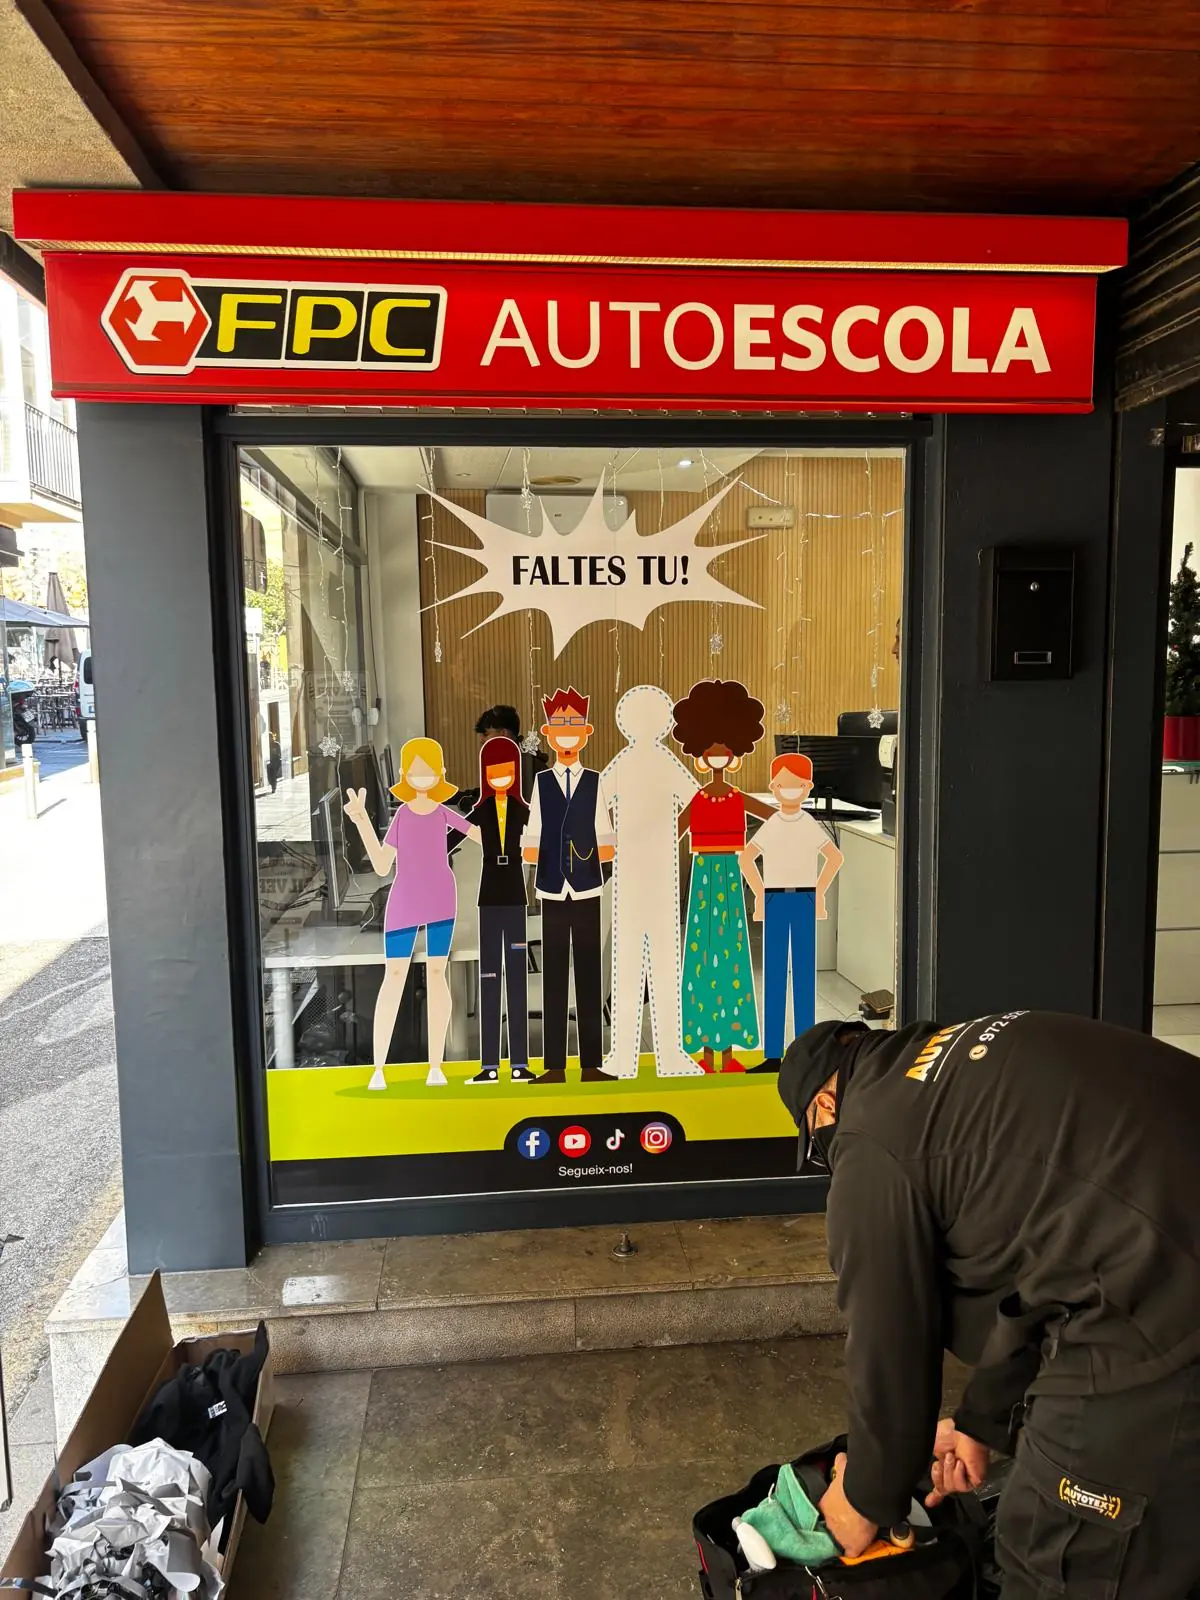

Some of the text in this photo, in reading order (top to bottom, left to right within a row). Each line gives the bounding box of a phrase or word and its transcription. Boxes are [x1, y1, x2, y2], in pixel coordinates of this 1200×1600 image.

[217, 293, 431, 357] FPC
[480, 298, 1052, 374] AUTOESCOLA
[512, 555, 689, 586] FALTES TU!
[979, 1021, 1010, 1042] 972
[558, 1163, 633, 1178] Segueix-nos!
[1063, 1486, 1115, 1512] AUTOTEXT
